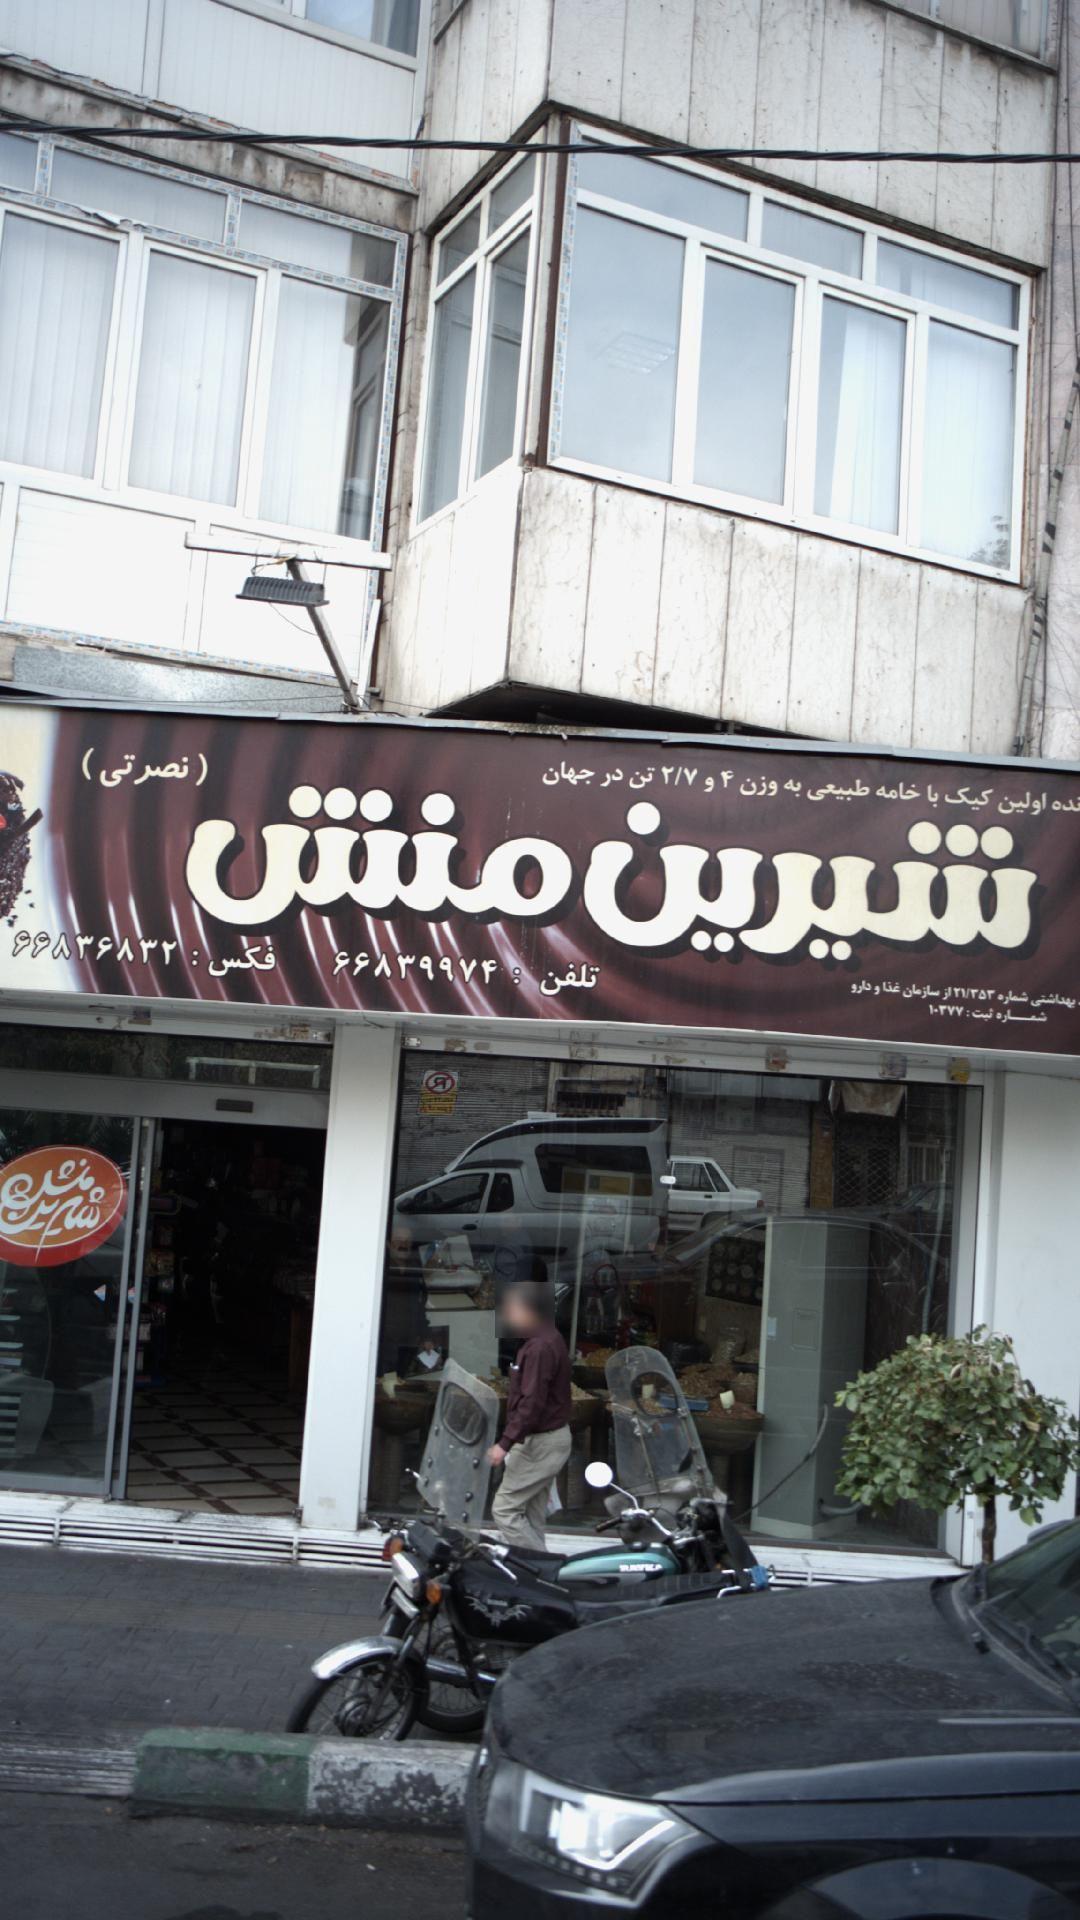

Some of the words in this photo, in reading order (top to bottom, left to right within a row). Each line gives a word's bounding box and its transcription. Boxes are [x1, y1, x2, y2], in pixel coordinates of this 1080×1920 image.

[542, 761, 595, 785] جهان
[600, 767, 624, 787] در
[628, 766, 656, 788] تن
[720, 769, 734, 788] ۴
[703, 775, 715, 792] و
[739, 776, 778, 796] وزن
[783, 778, 802, 797] به
[806, 779, 870, 801] طبیعی
[875, 782, 921, 800] خامه
[926, 784, 939, 808] با
[944, 787, 993, 811] کیک
[997, 792, 1047, 815] اولین
[185, 785, 573, 925] منش
[584, 801, 1038, 961] شیرین
[11, 929, 178, 966] ۶۶۸۳۶۸۳۲
[207, 944, 277, 977] فکس
[331, 950, 499, 985] ۶۶۸۳۹۹۷۴
[538, 961, 601, 996] تلفن
[850, 980, 871, 993] دارو
[882, 981, 900, 994] غذا
[873, 985, 881, 995] و
[902, 983, 940, 998] سازمان
[944, 985, 952, 1000] از
[997, 991, 1028, 1005] شماره
[1030, 992, 1076, 1009] بهداشتی
